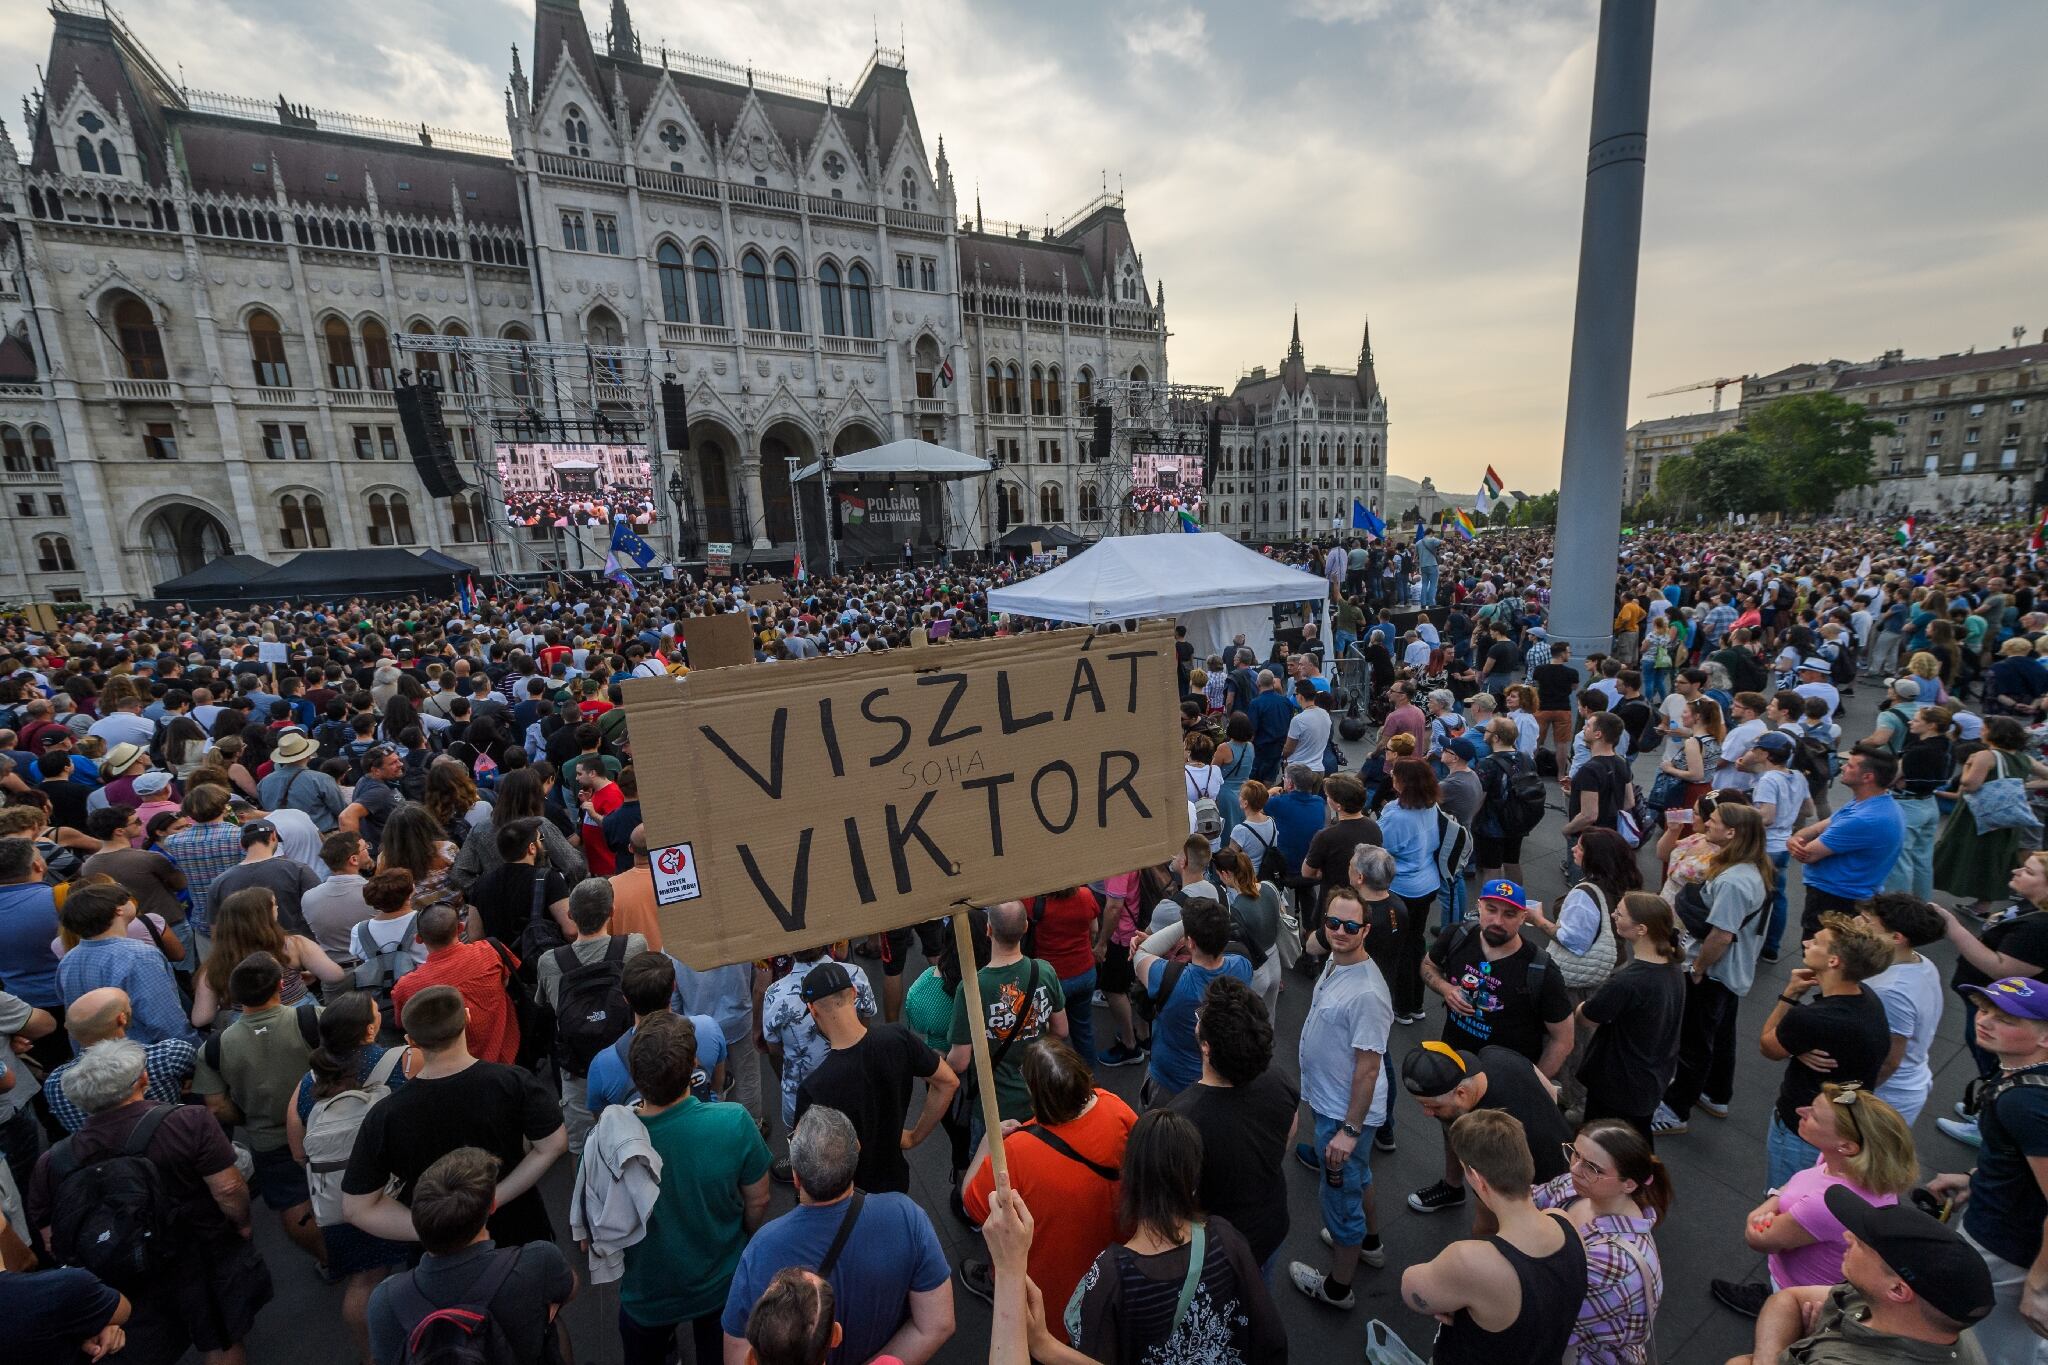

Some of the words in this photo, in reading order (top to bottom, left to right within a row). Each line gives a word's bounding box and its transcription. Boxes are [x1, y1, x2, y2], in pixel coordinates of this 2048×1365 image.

[868, 495, 920, 510] POLGÁRI
[870, 510, 920, 523] ELLENÁLLÁS
[699, 634, 1158, 799] VISZLÁT
[898, 750, 984, 790] SOHA
[736, 750, 1152, 932] VIKTOR
